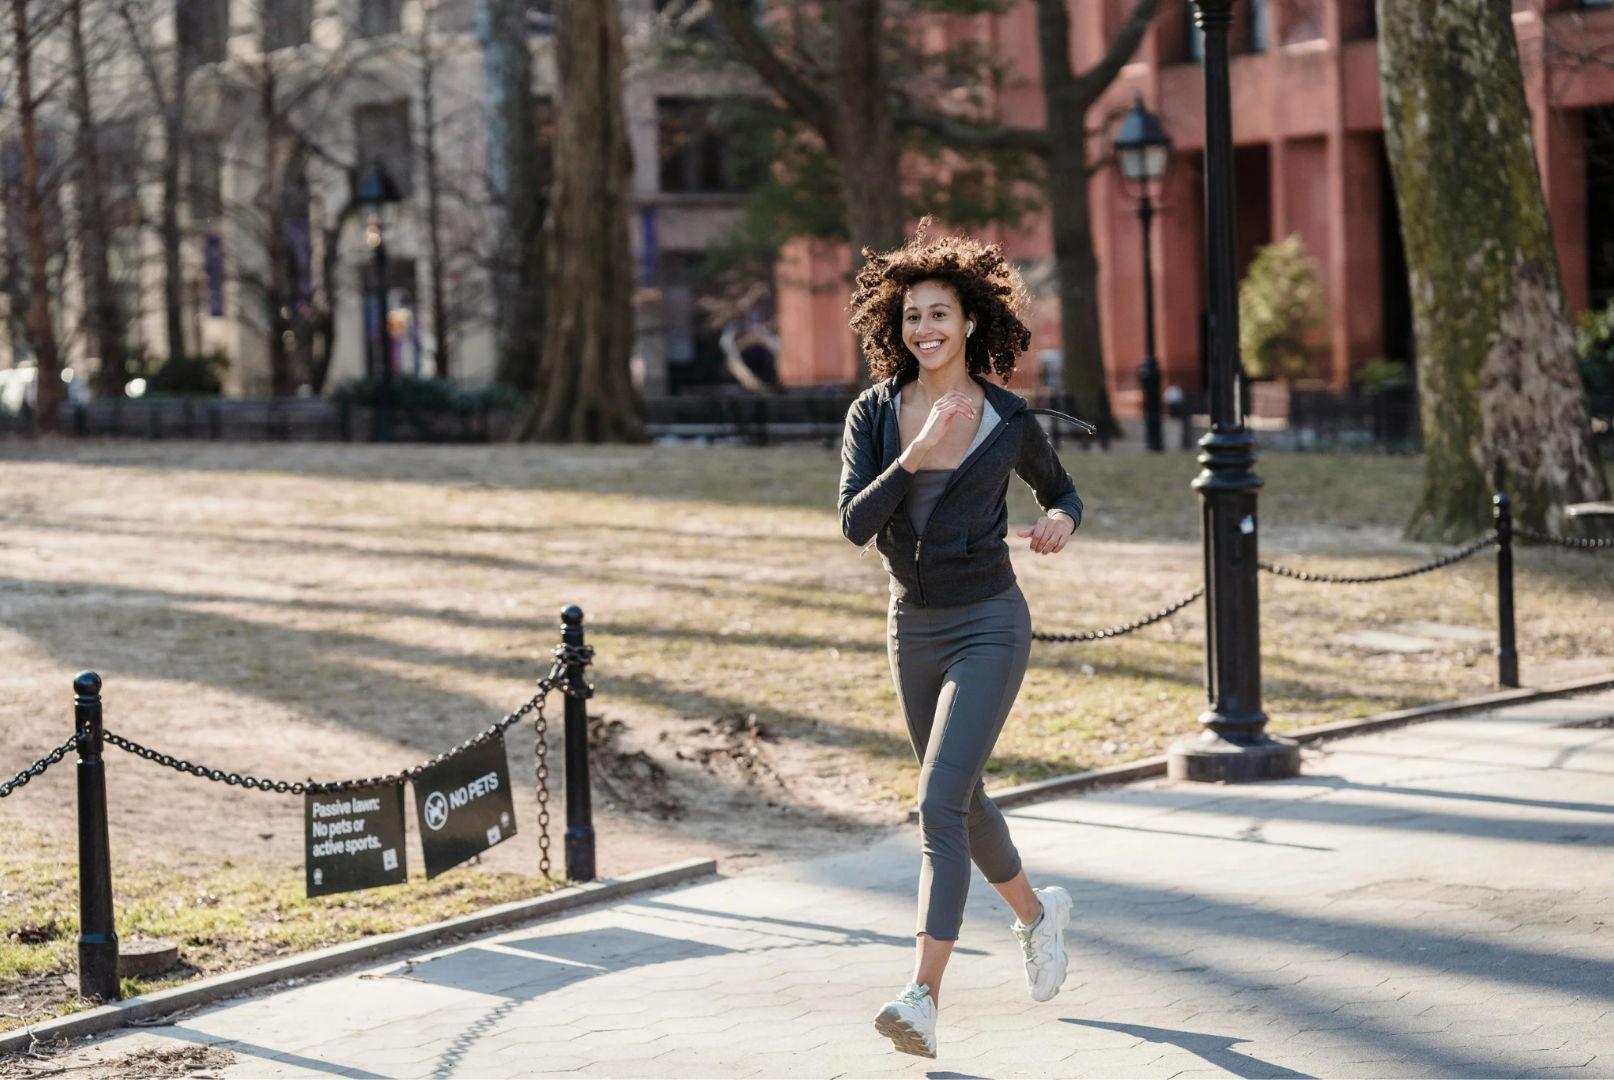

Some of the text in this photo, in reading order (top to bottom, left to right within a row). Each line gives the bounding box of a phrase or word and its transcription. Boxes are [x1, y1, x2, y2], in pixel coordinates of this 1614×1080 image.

[449, 771, 499, 810] NO PETS
[312, 799, 352, 818] Passive
[312, 819, 366, 839] No pets or
[312, 834, 382, 857] active sports.
